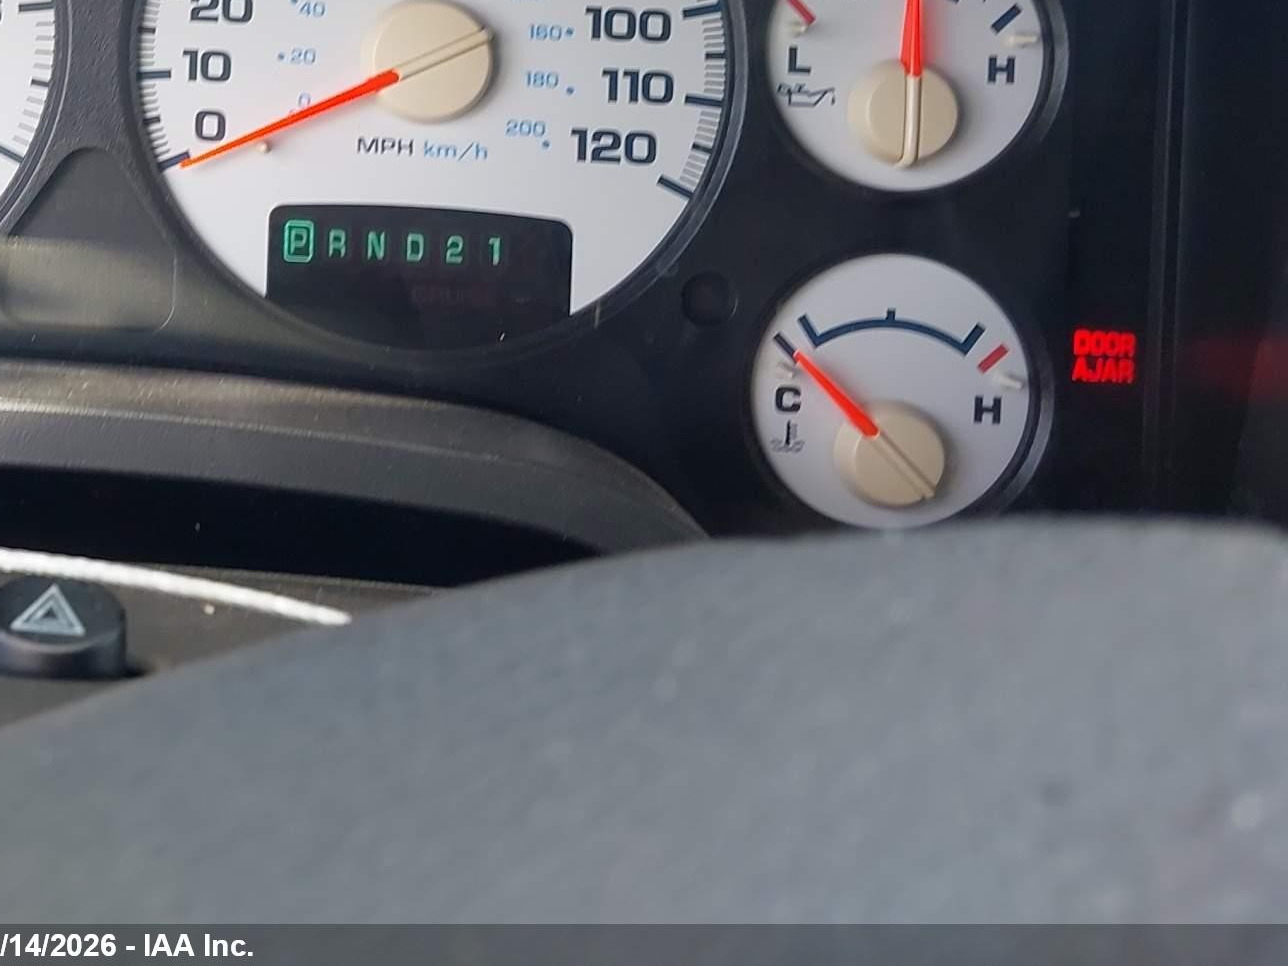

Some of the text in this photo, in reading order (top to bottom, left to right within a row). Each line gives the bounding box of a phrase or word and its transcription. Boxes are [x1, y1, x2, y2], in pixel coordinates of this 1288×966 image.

[299, 1, 326, 17] 40
[530, 24, 563, 41] 160
[585, 6, 672, 43] 100
[182, 49, 232, 82] 10
[290, 48, 316, 64] 20
[787, 46, 812, 74] L
[987, 56, 1016, 84] H
[526, 72, 559, 88] 180
[602, 69, 674, 104] 110
[194, 110, 226, 142] 0
[506, 120, 546, 137] 200
[357, 137, 488, 161] MPH km/h
[571, 128, 657, 165] 120
[290, 228, 501, 266] P R N D 2 1
[1073, 329, 1136, 357] DOOR
[1071, 355, 1135, 384] AJAR
[774, 386, 801, 413] C
[973, 395, 1002, 425] H
